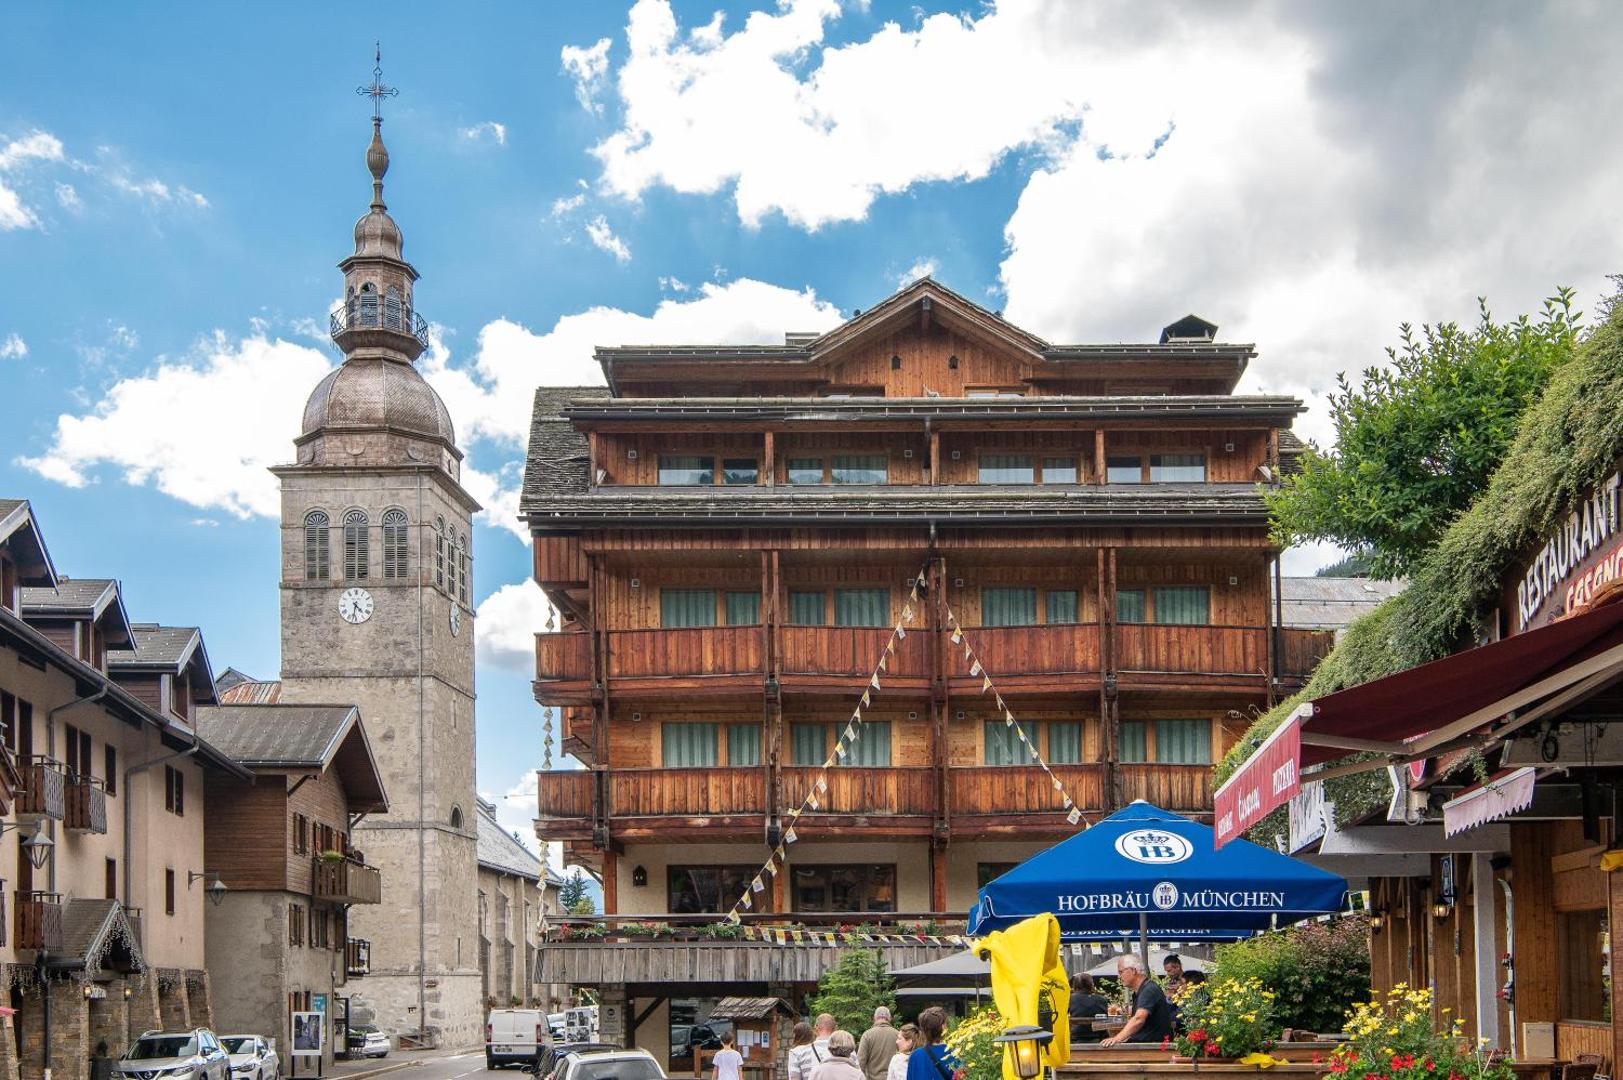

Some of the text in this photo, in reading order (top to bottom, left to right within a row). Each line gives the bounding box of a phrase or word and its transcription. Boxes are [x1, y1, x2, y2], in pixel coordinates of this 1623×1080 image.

[1518, 471, 1621, 631] RESTAURANT
[1057, 890, 1149, 911] HOFBRÄU
[1182, 889, 1285, 908] MÜNCHEN
